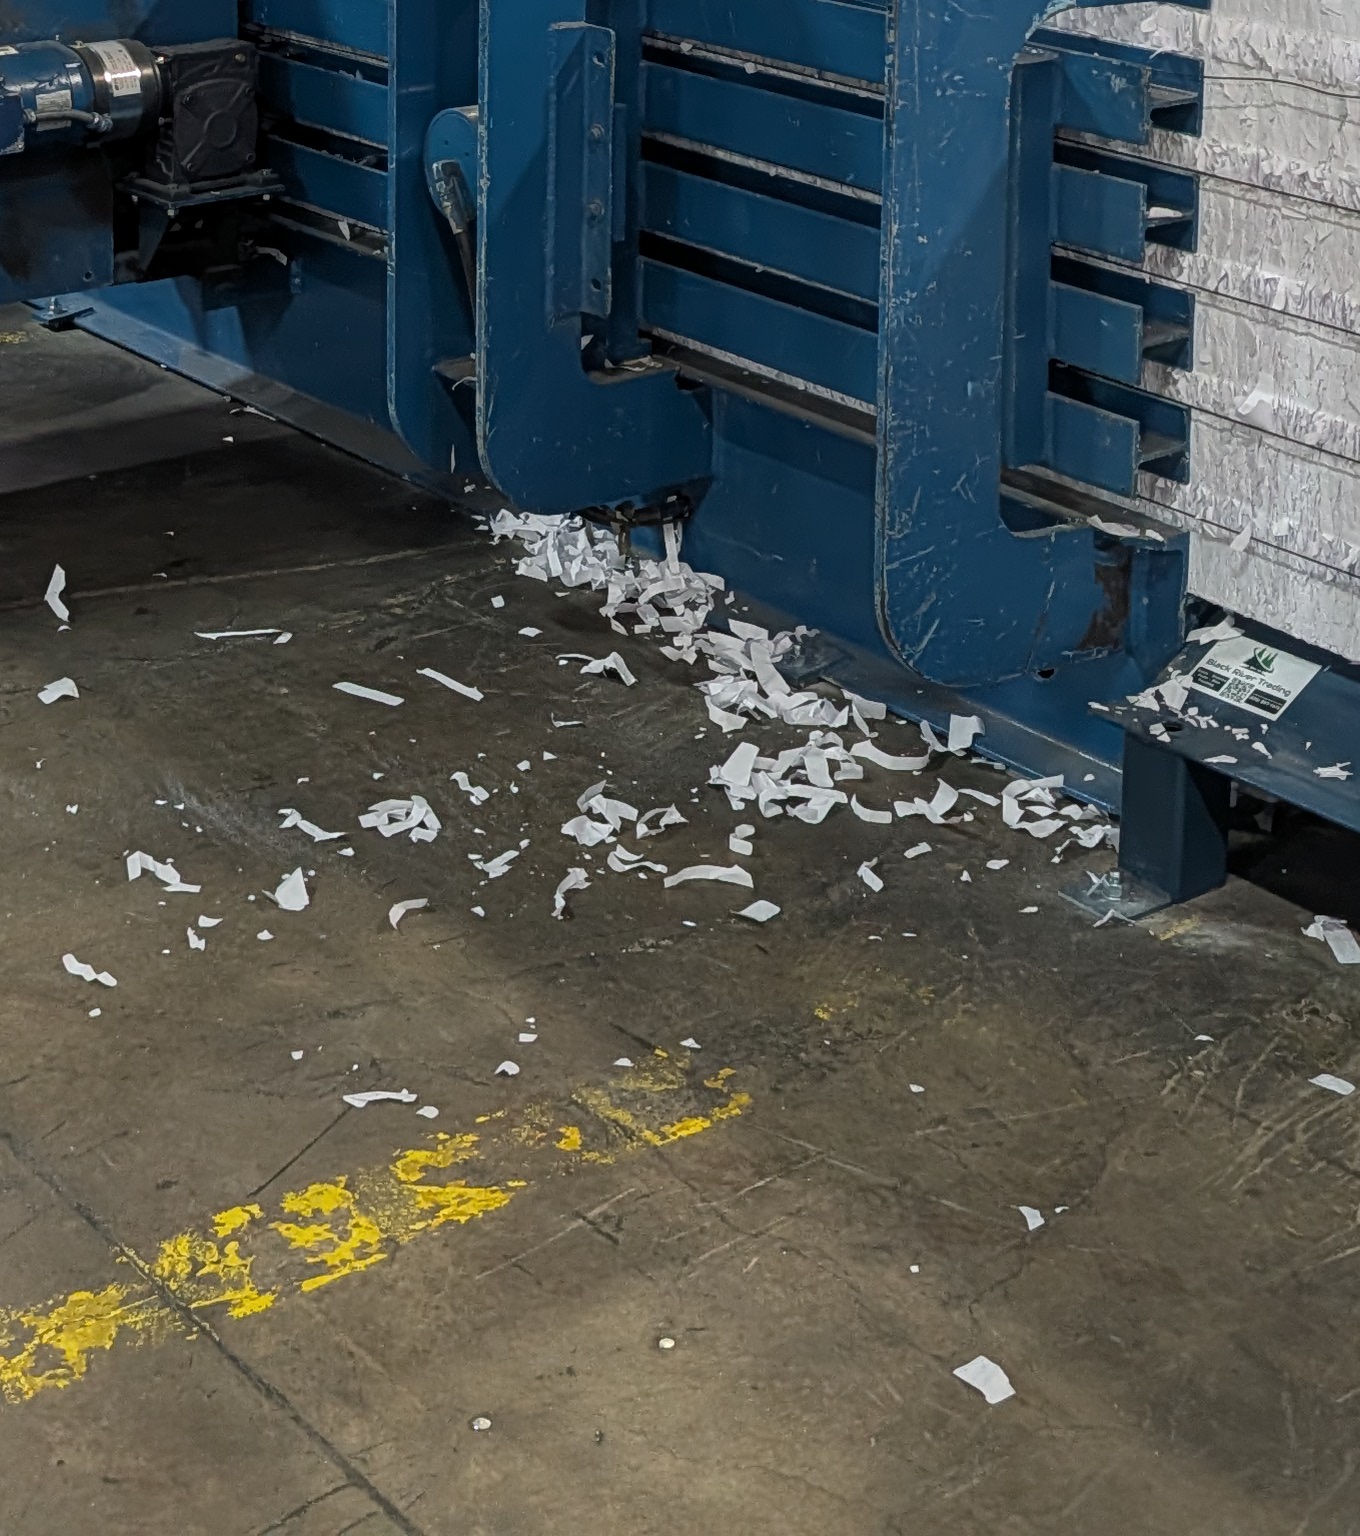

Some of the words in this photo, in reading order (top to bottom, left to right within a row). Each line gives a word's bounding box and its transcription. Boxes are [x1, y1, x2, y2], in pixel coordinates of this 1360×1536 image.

[1206, 658, 1232, 672] Black
[1232, 668, 1257, 681] River
[1258, 678, 1292, 697] Trading
